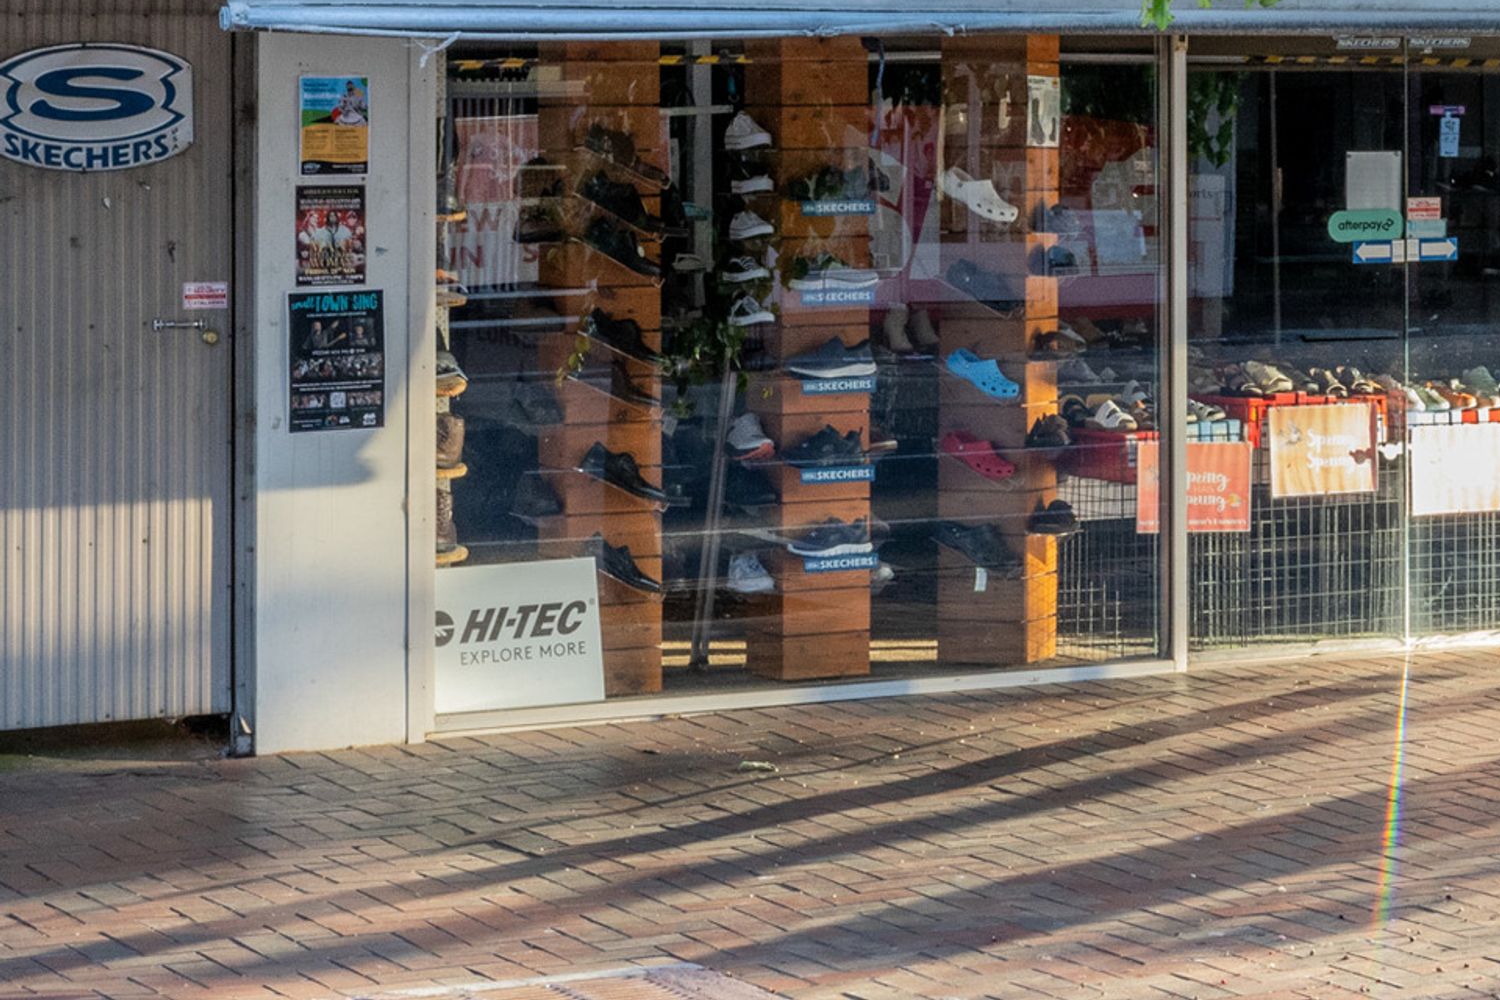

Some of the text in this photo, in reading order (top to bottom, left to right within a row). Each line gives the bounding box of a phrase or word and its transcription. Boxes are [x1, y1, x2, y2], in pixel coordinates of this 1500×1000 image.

[4, 133, 170, 169] SKECHERS
[816, 202, 871, 211] SKECHERS
[1337, 220, 1383, 232] afterpay
[817, 291, 870, 300] SKECHERS
[315, 295, 348, 312] TOWN
[818, 380, 871, 391] SKECHERS
[816, 469, 870, 479] SKECHERS
[1187, 471, 1229, 492] pring
[820, 557, 873, 569] SKECHERS
[459, 600, 587, 644] HI-TEC
[460, 641, 587, 665] EXPLORE MORE
